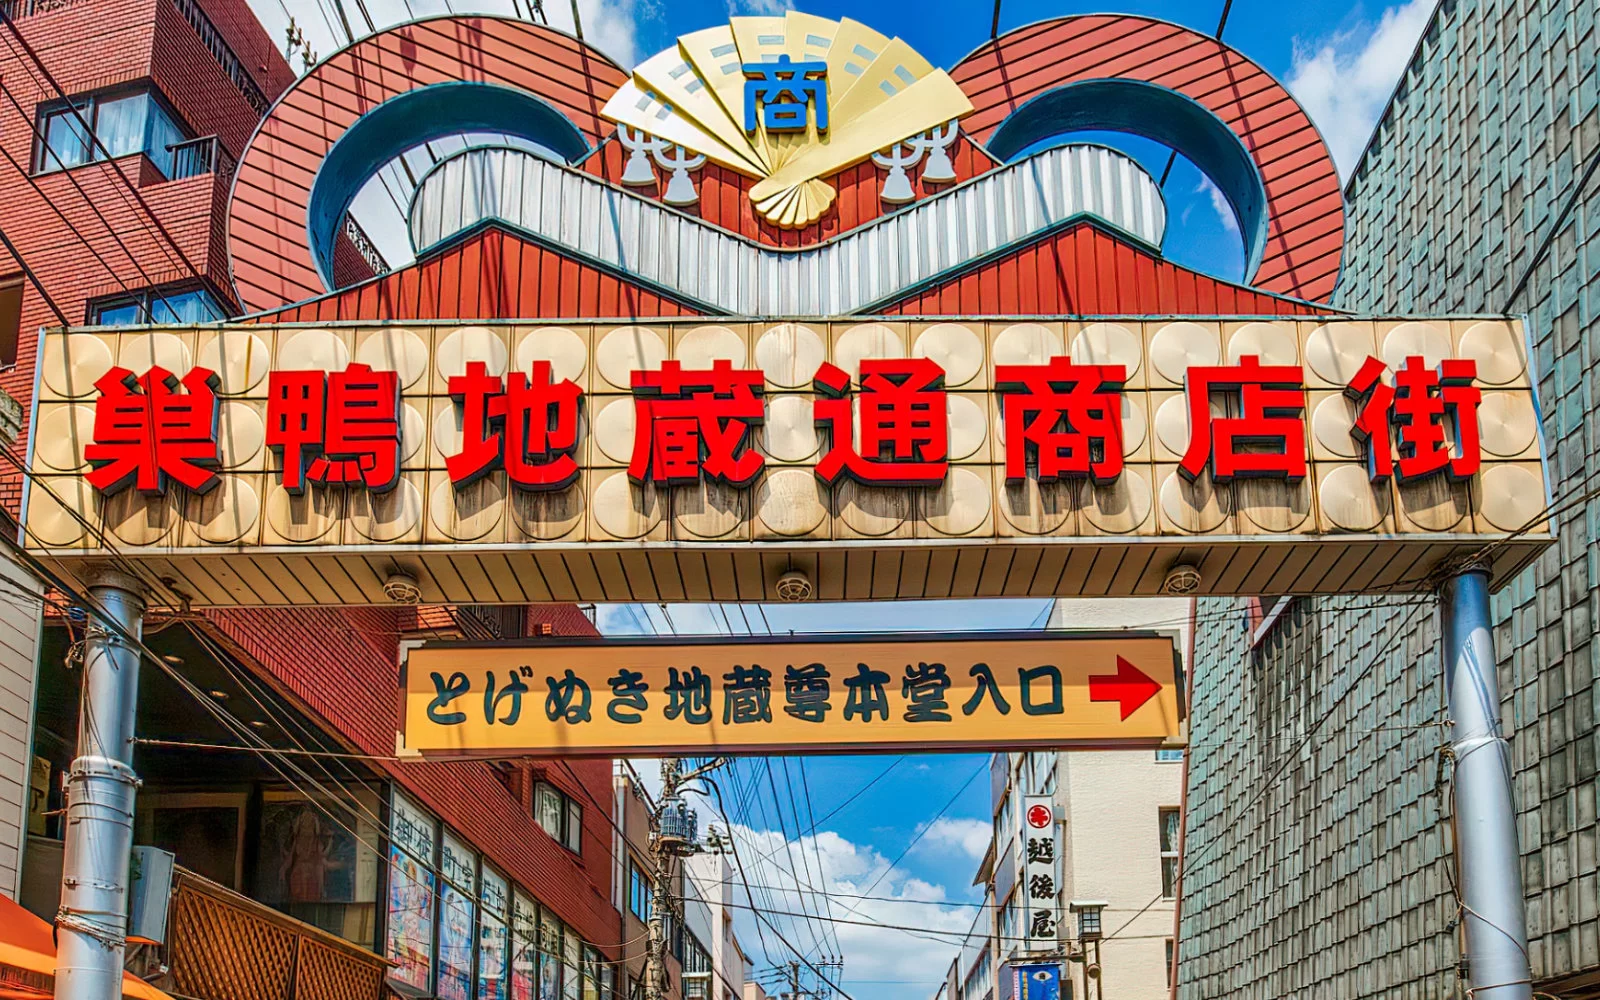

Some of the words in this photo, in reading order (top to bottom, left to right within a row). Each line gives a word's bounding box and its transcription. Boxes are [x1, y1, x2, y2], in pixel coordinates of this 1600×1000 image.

[742, 54, 828, 135] 商
[84, 355, 1482, 495] 巣鴨地蔵通商店街
[425, 661, 1064, 726] とげぬき地蔵尊本堂入口
[1027, 837, 1056, 937] 越後屋
